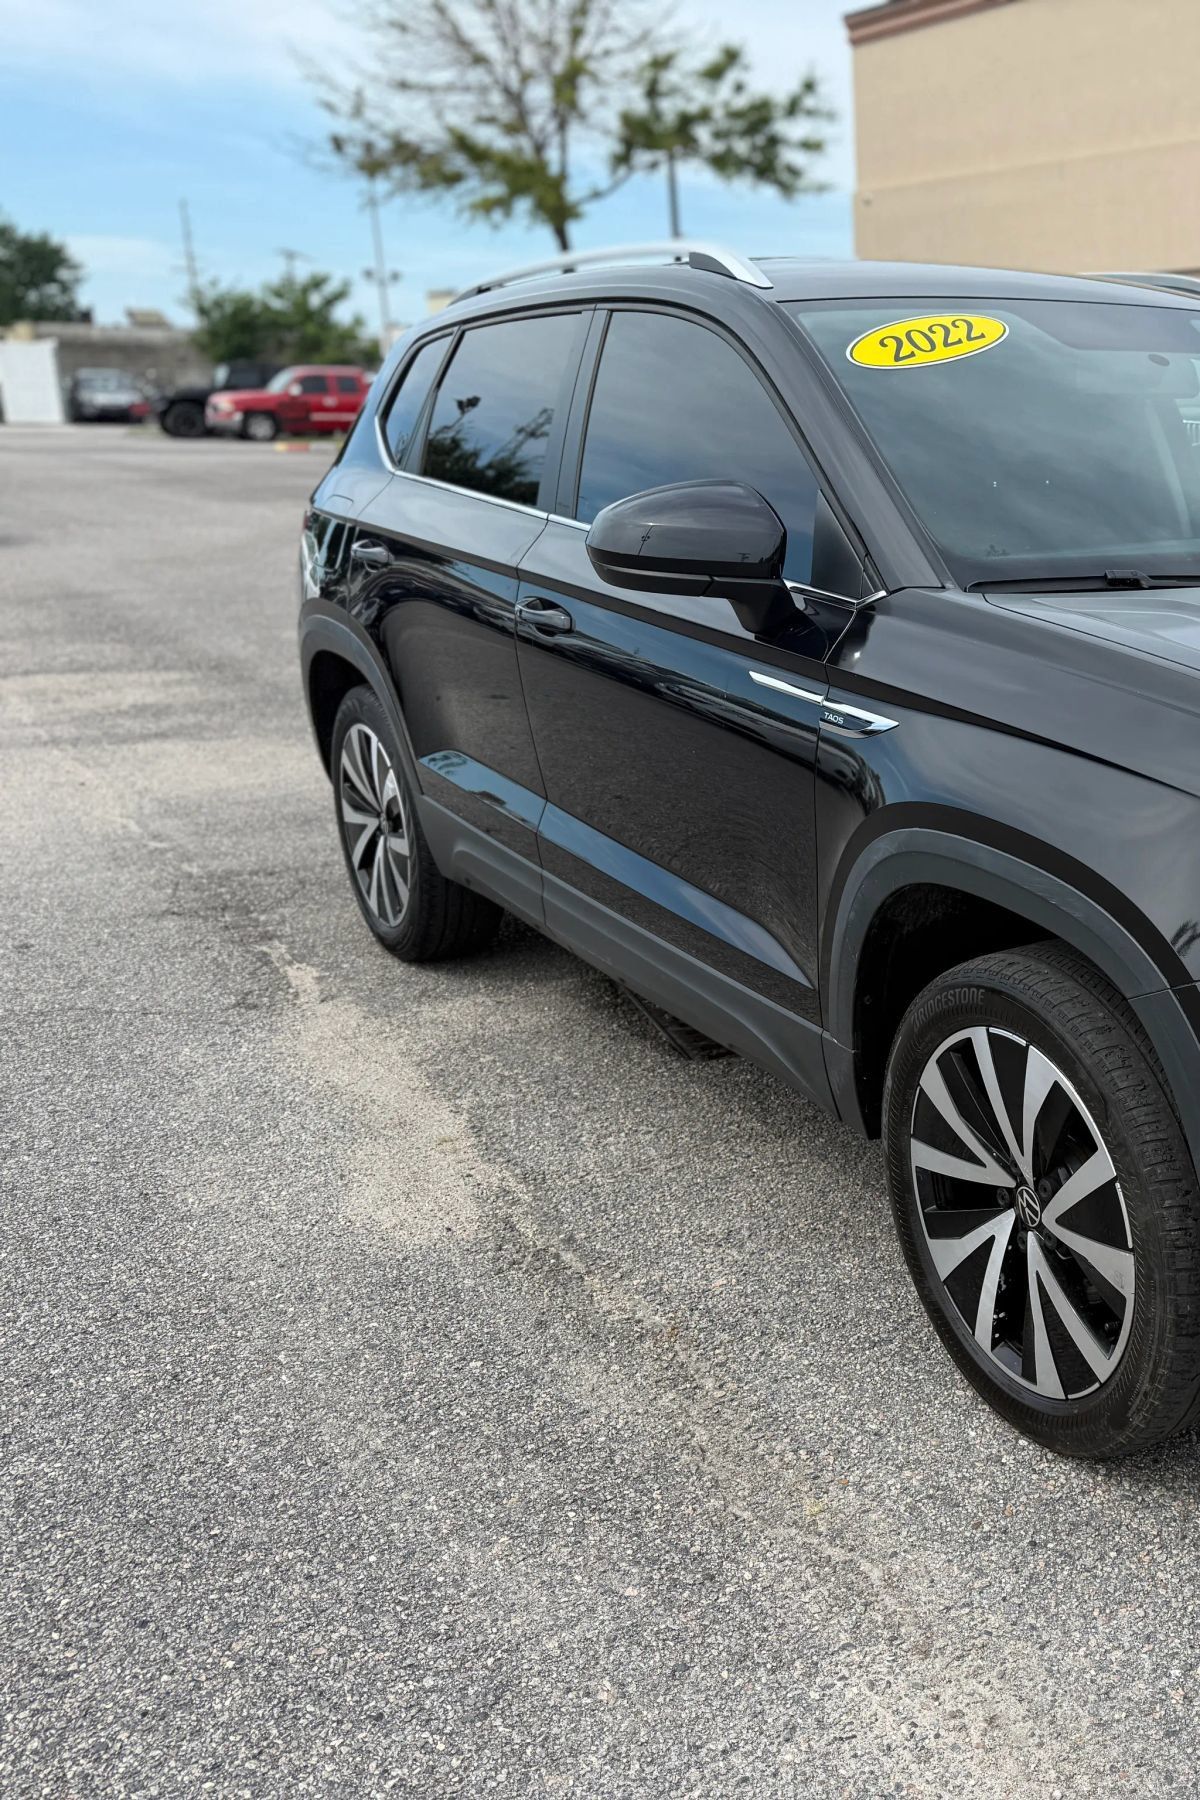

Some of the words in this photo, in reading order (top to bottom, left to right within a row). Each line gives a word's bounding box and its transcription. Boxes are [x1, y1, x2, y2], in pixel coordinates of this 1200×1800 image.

[879, 318, 986, 363] 2022
[824, 711, 844, 725] TAOS
[911, 987, 986, 1030] BRIDGESTONE
